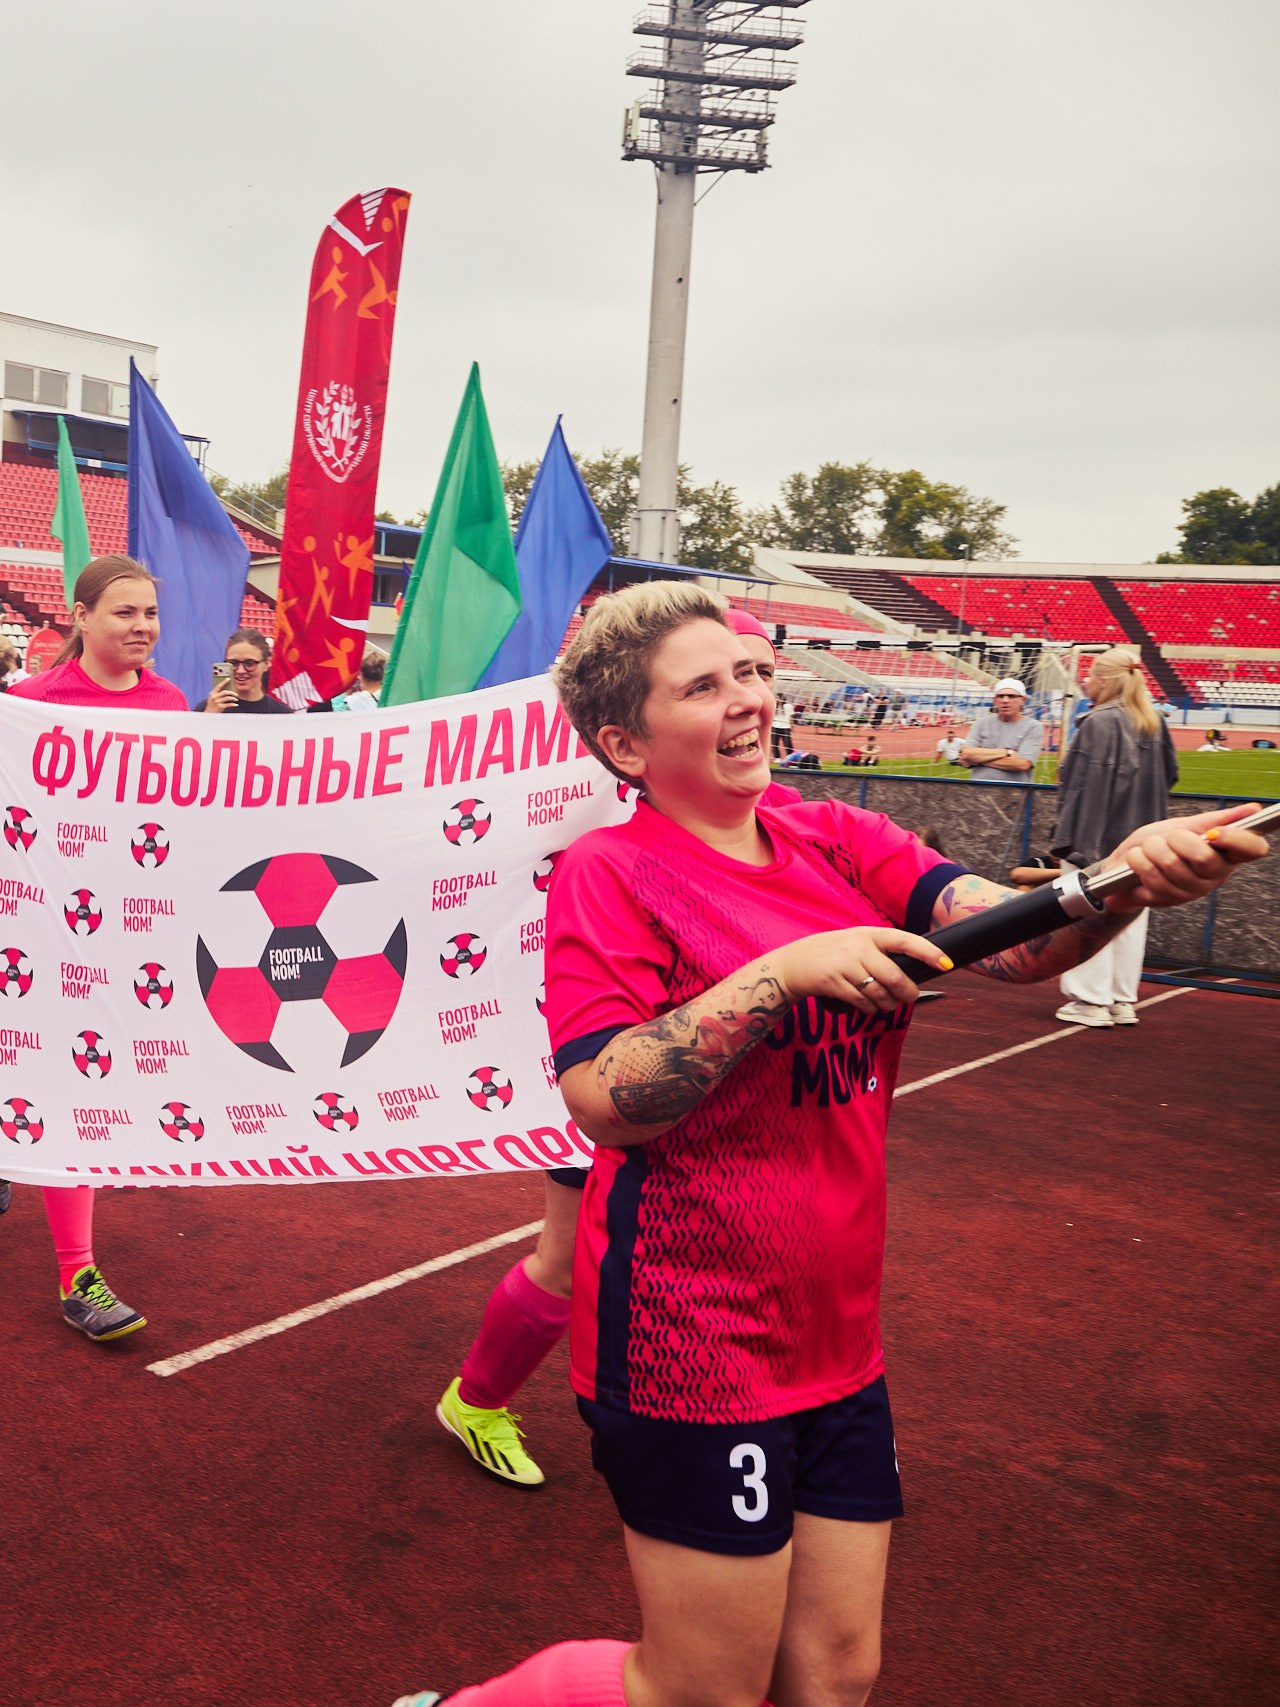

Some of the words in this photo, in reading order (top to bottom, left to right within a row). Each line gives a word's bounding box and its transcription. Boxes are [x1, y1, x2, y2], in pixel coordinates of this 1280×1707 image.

[32, 725, 410, 809] ФУТБОЛЬНЫЕ
[528, 781, 594, 811] FOOTBALL
[528, 804, 563, 827] MOM!
[57, 822, 108, 842] FOOTBALL
[57, 840, 84, 858] MOM!
[433, 870, 498, 896] FOOTBALL
[123, 898, 176, 916] FOOTBALL
[432, 892, 467, 912] MOM!
[123, 915, 153, 933] MOM!
[269, 946, 324, 967] FOOTBALL
[61, 962, 110, 985] FOOTBALL
[271, 964, 301, 981] MOM!
[61, 980, 92, 1000] MOM!
[438, 999, 502, 1028] FOOTBALL
[441, 1023, 477, 1045] MOM!
[133, 1040, 190, 1057] FOOTBALL
[135, 1057, 167, 1074] MOM!
[791, 1035, 881, 1107] MOM!
[377, 1084, 440, 1105] FOOTBALL
[73, 1108, 133, 1125] FOOTBALL
[225, 1103, 288, 1121] FOOTBALL
[383, 1103, 418, 1122] MOM!
[77, 1125, 111, 1141] MOM!
[231, 1120, 266, 1135] MOM!
[729, 1443, 769, 1523] 3
